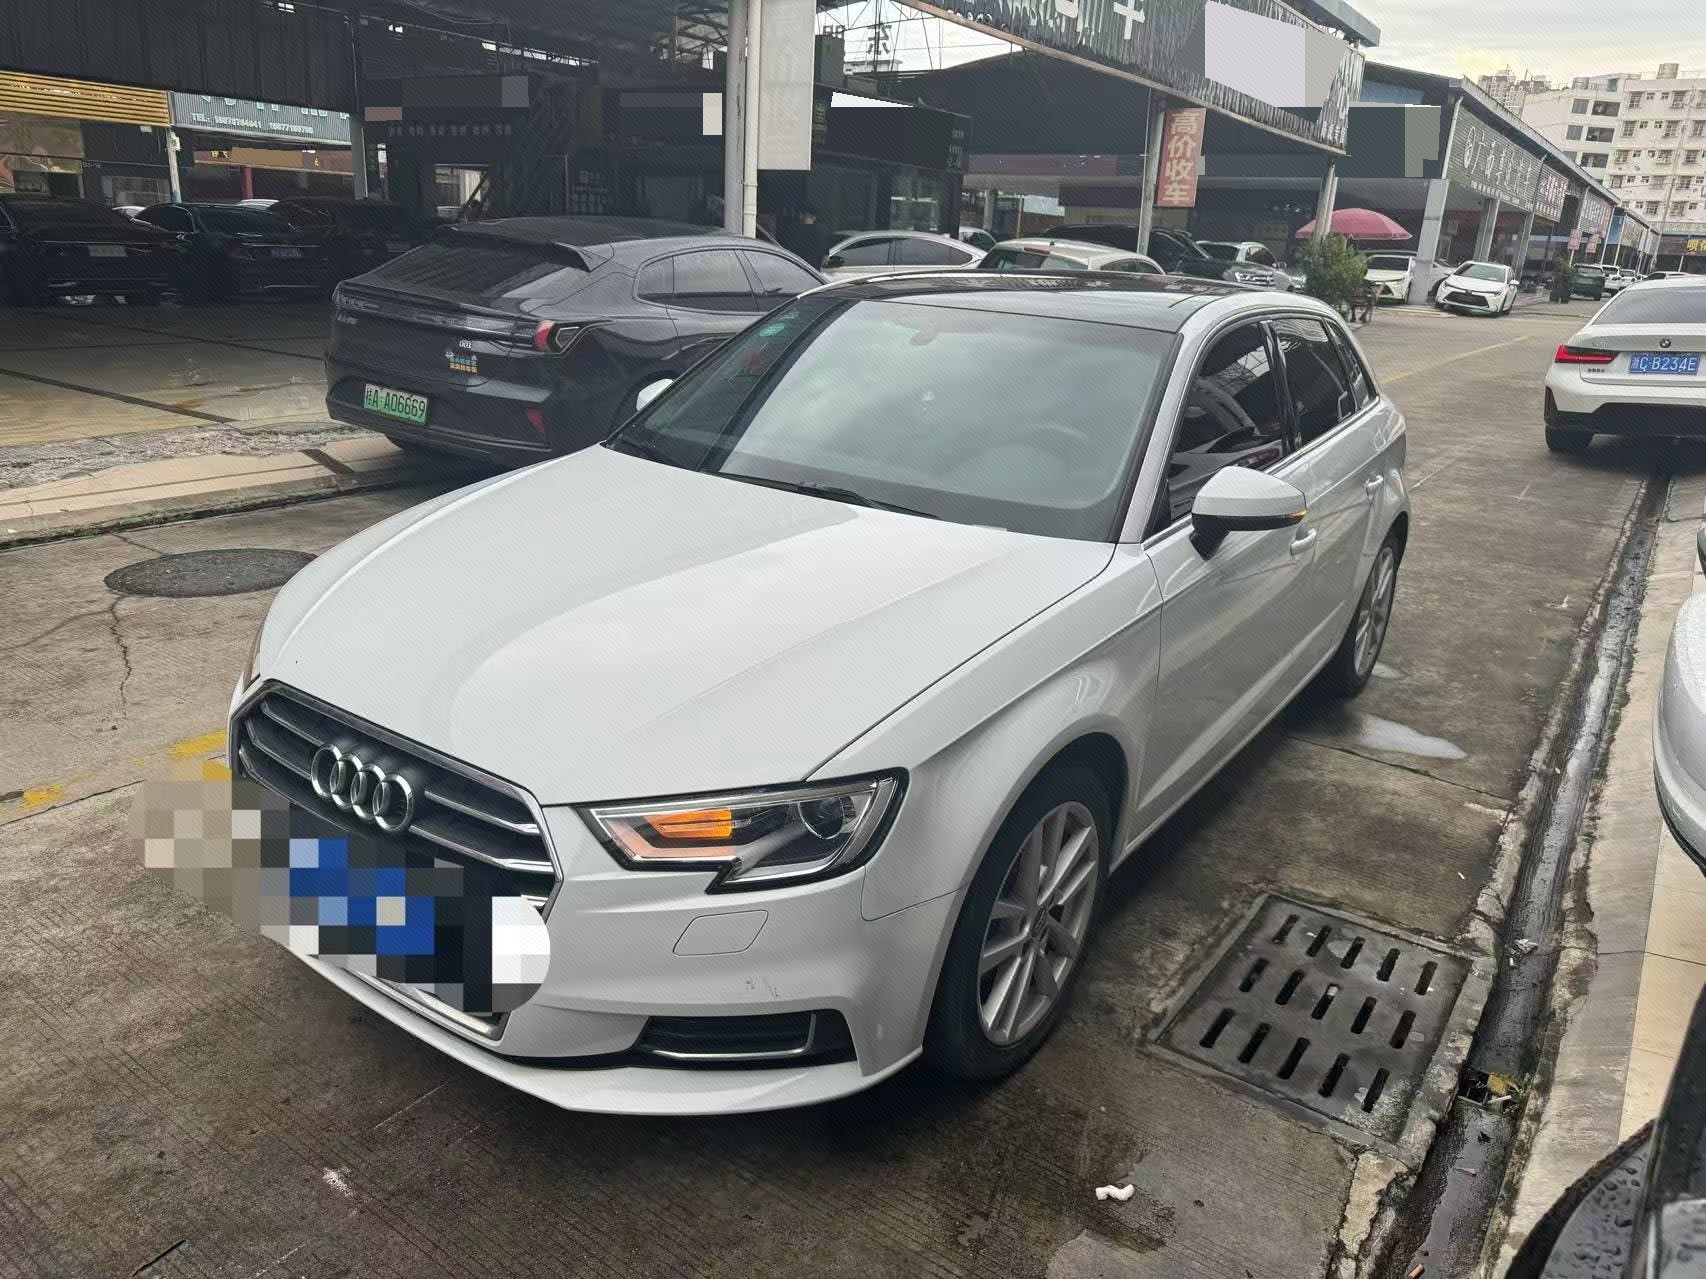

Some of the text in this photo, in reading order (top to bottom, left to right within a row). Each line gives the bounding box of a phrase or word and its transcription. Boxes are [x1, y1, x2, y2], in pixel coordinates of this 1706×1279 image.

[1162, 111, 1200, 205] 高价收车
[459, 340, 472, 349] 001
